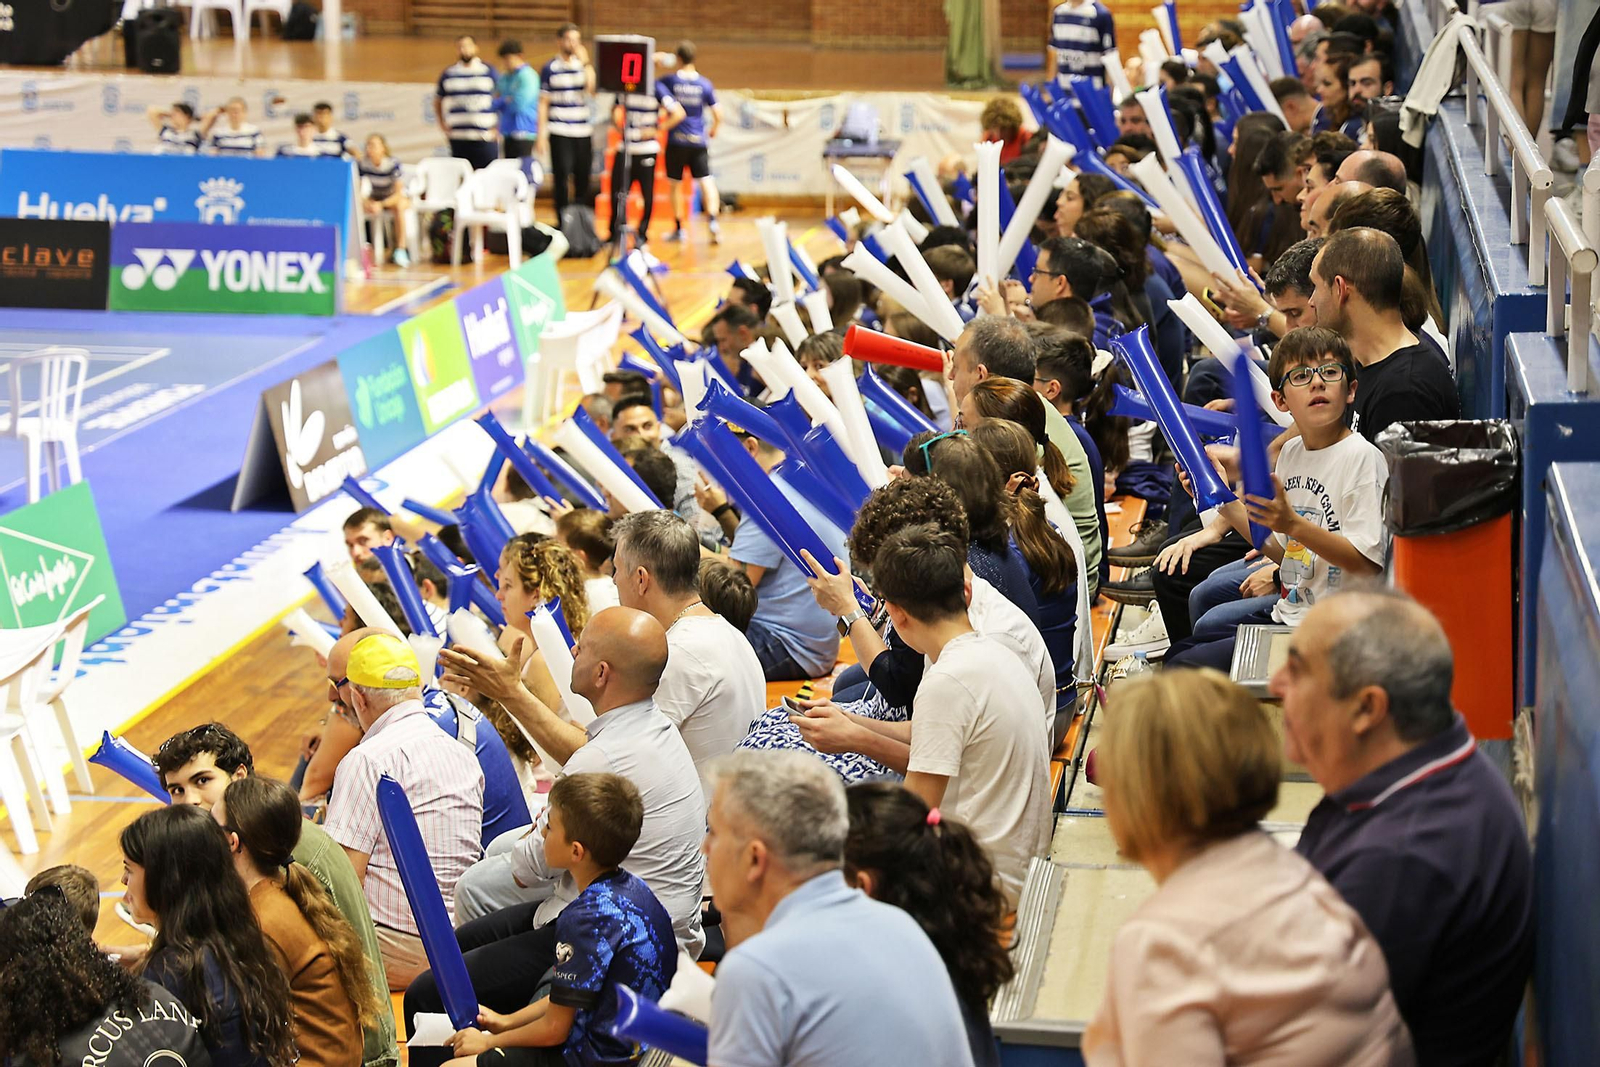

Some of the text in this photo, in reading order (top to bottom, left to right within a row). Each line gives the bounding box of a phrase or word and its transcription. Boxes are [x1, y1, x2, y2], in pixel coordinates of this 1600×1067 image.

[621, 53, 643, 83] 0
[2, 243, 95, 268] clave
[200, 249, 326, 293] YONEX
[1305, 476, 1325, 495] KEP
[1320, 493, 1341, 532] CALM
